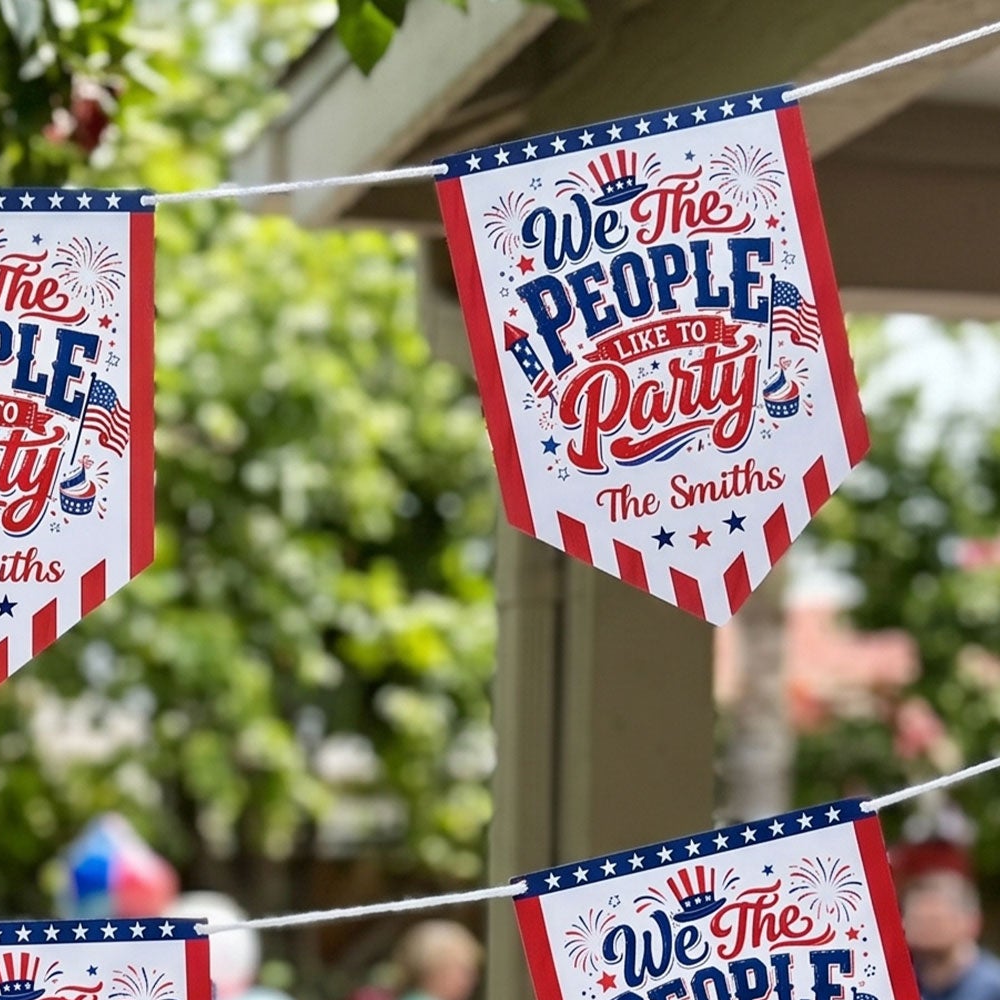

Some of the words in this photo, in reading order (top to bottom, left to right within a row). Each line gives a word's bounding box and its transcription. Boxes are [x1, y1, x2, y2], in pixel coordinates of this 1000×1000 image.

[522, 194, 628, 270] We
[631, 166, 734, 245] The
[516, 237, 774, 374] PEOPLE
[615, 329, 667, 359] LIKE
[676, 322, 706, 344] TO
[559, 335, 763, 474] Party
[596, 484, 660, 522] The
[670, 458, 785, 507] Smiths
[602, 910, 708, 988] We
[710, 880, 814, 960] The
